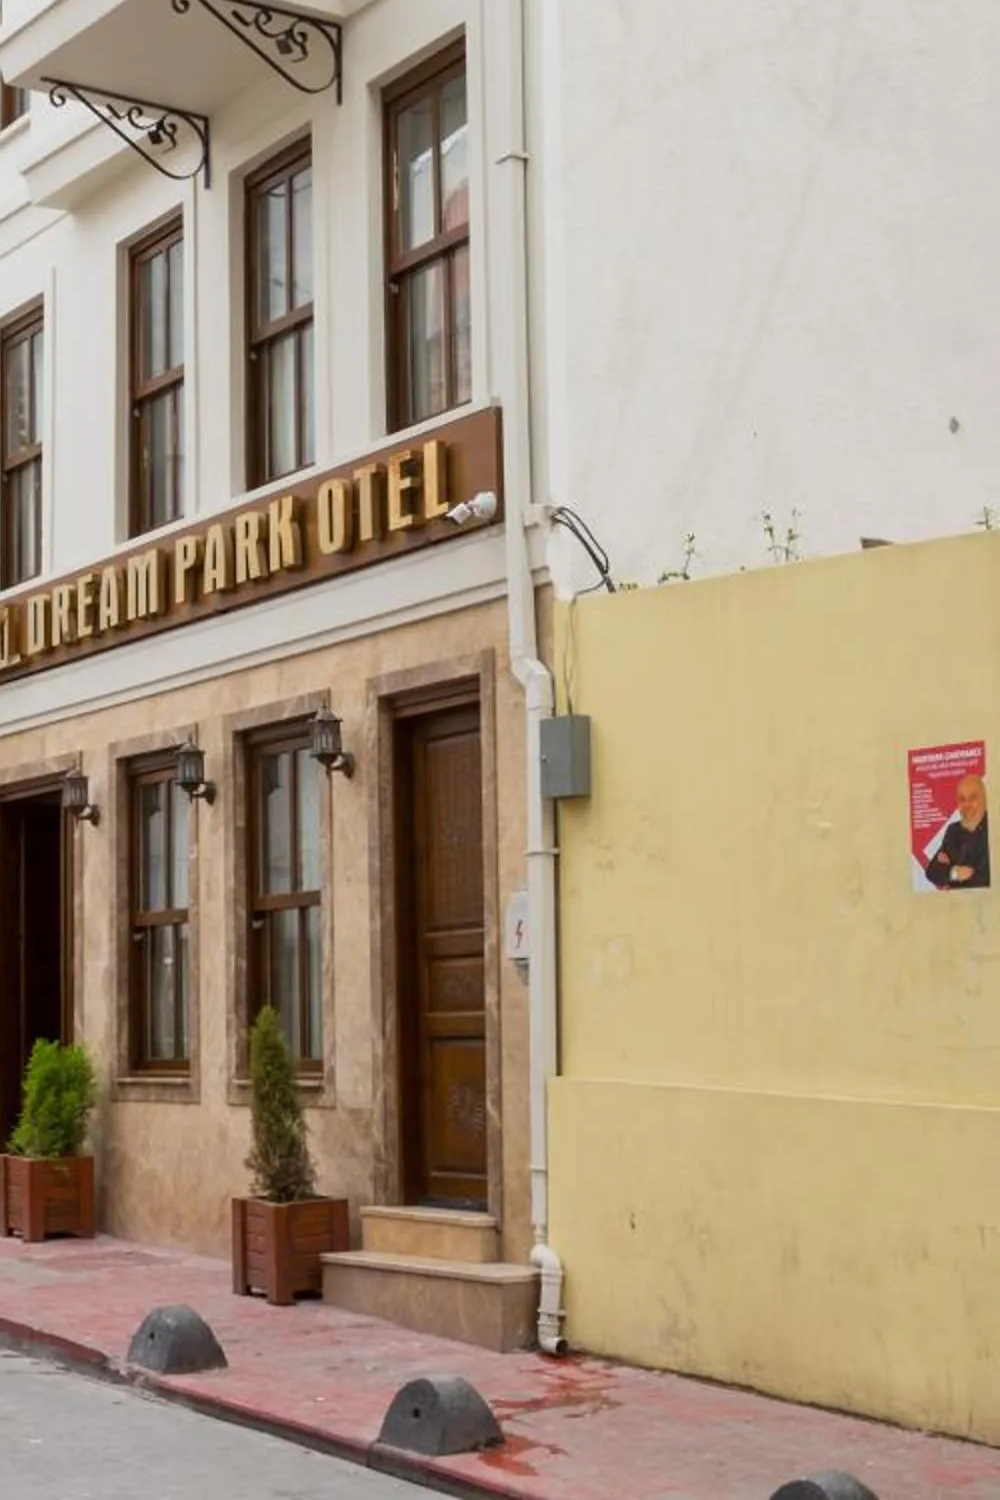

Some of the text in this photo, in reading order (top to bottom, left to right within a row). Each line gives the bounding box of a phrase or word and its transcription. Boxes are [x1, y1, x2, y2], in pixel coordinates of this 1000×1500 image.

[27, 439, 451, 654] DREAM PARK OTEL
